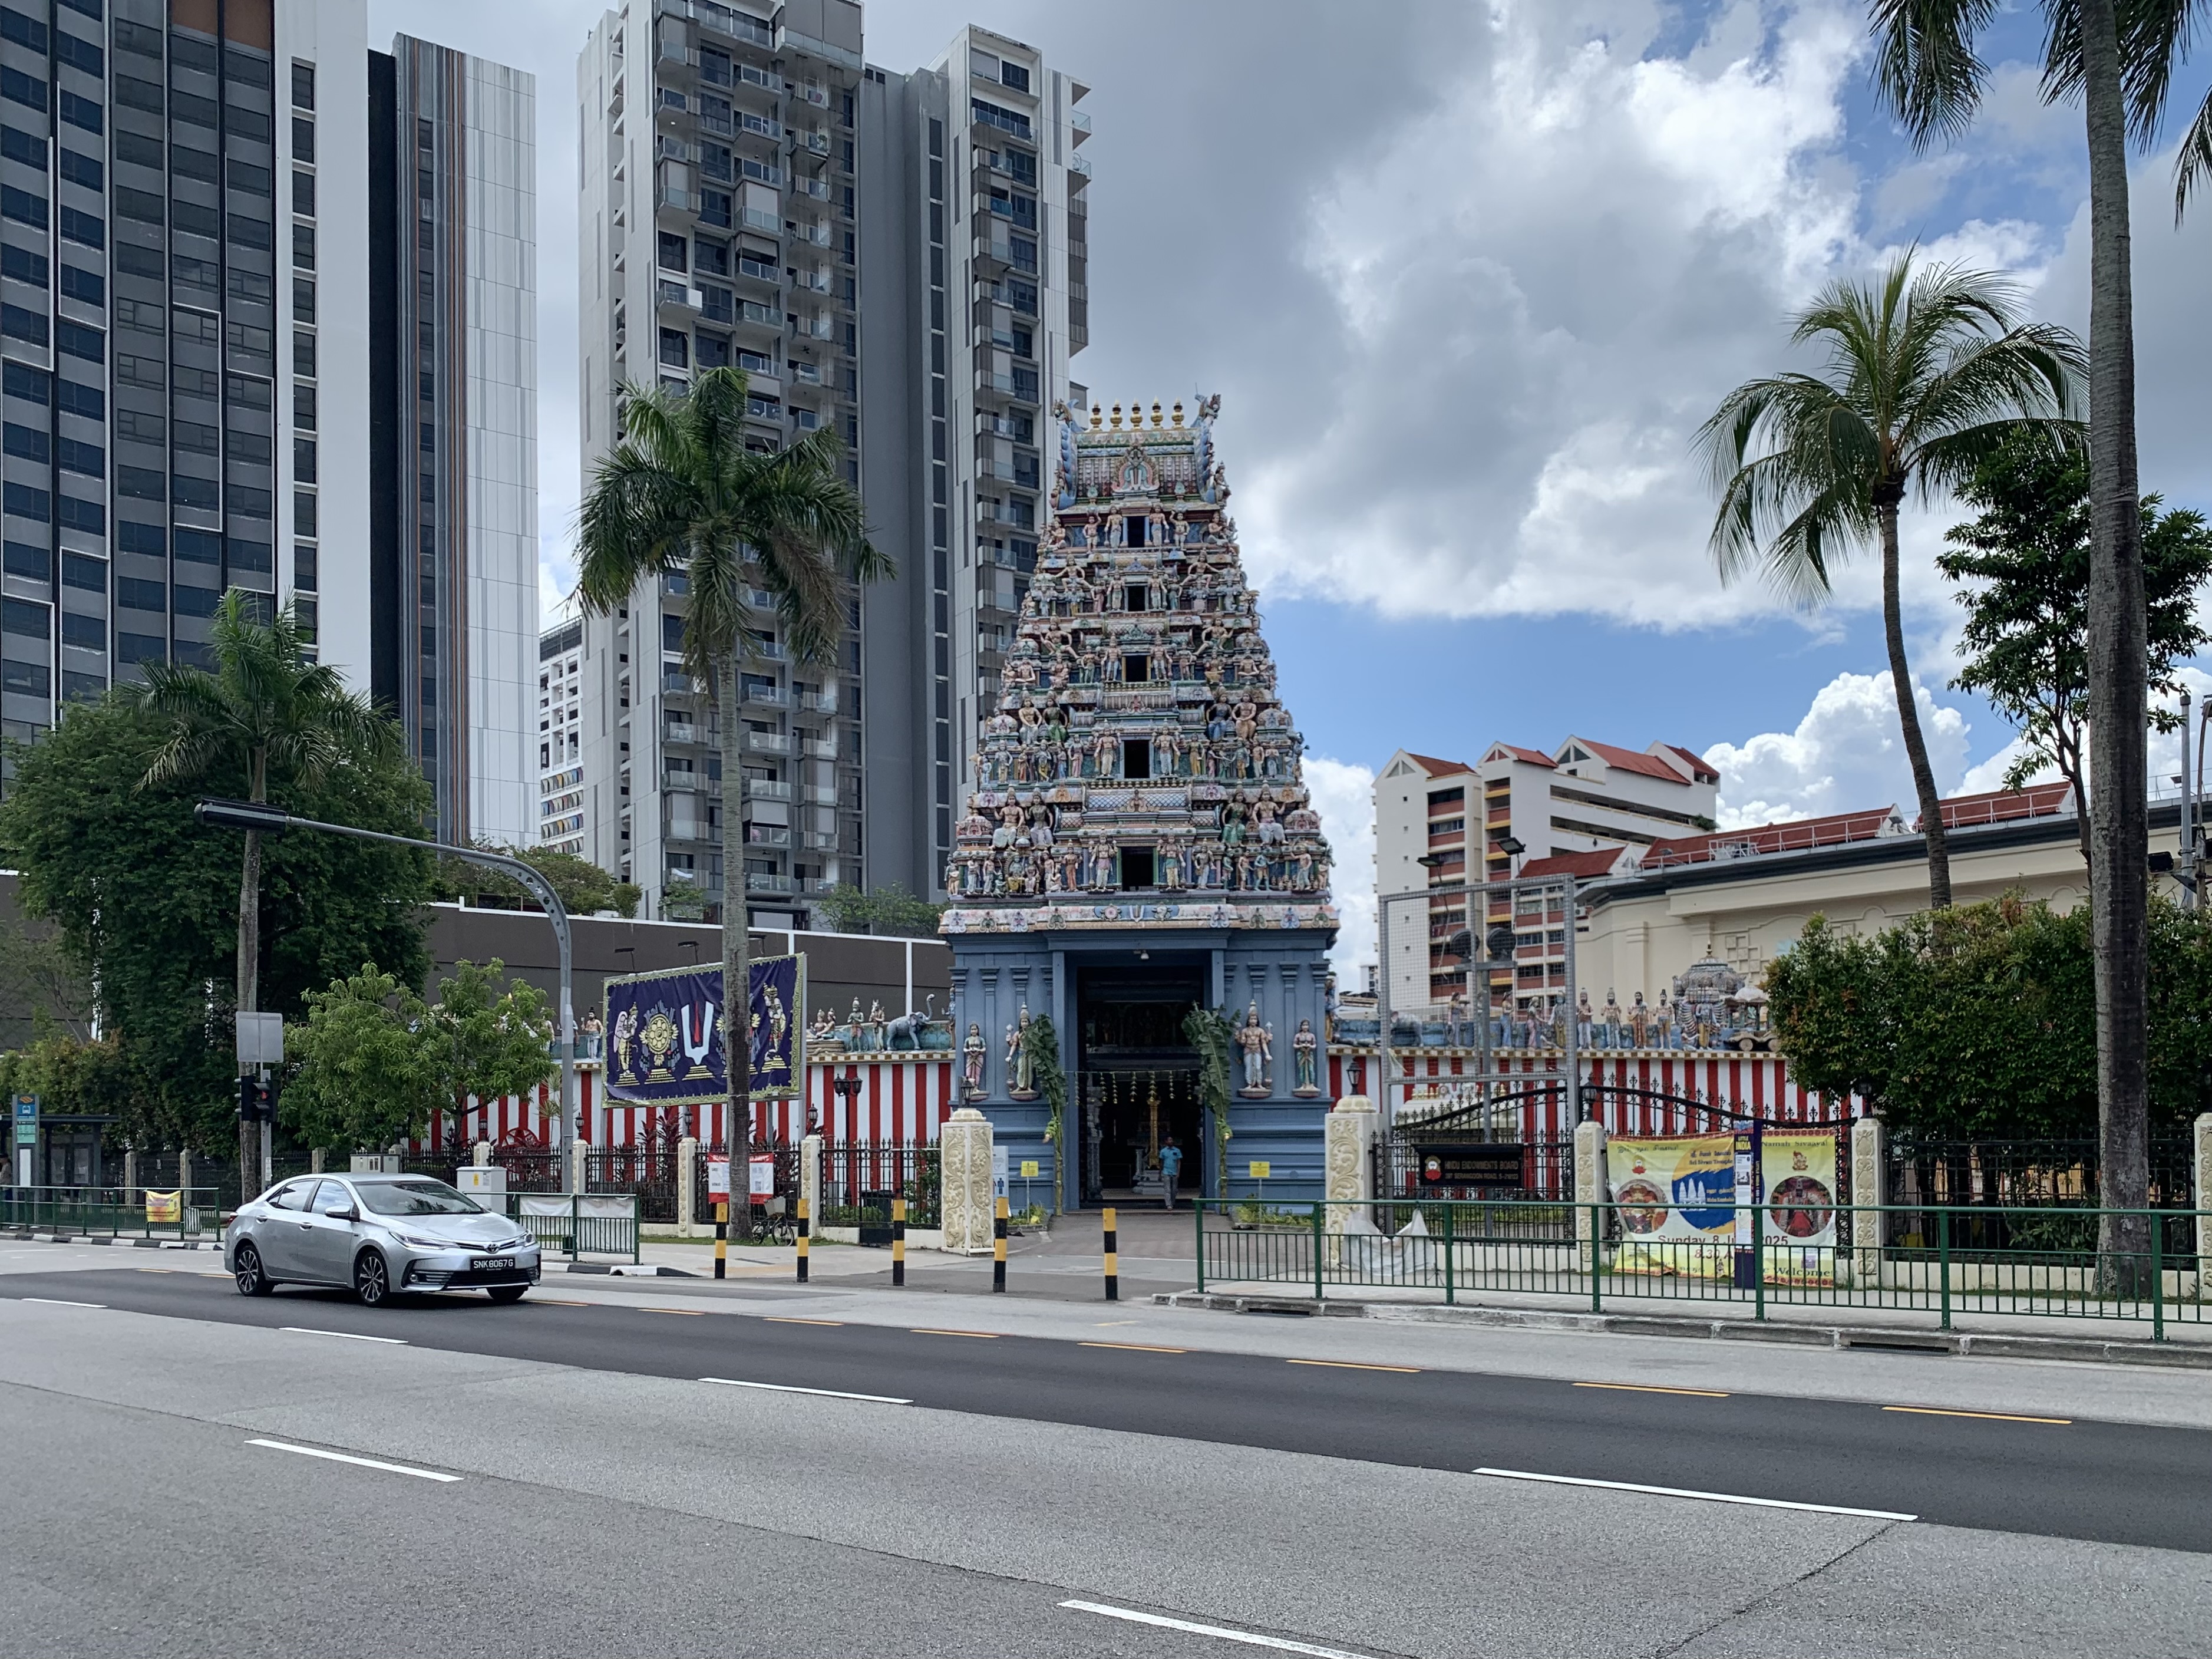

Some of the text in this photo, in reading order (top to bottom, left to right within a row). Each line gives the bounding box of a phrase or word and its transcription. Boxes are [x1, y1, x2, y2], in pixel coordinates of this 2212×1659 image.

[1735, 1141, 1751, 1150] INDIA
[1445, 1161, 1518, 1169] HINDU ENDOWMENTS BOARD
[1713, 1235, 1719, 1245] 8
[1762, 1236, 1788, 1245] 025
